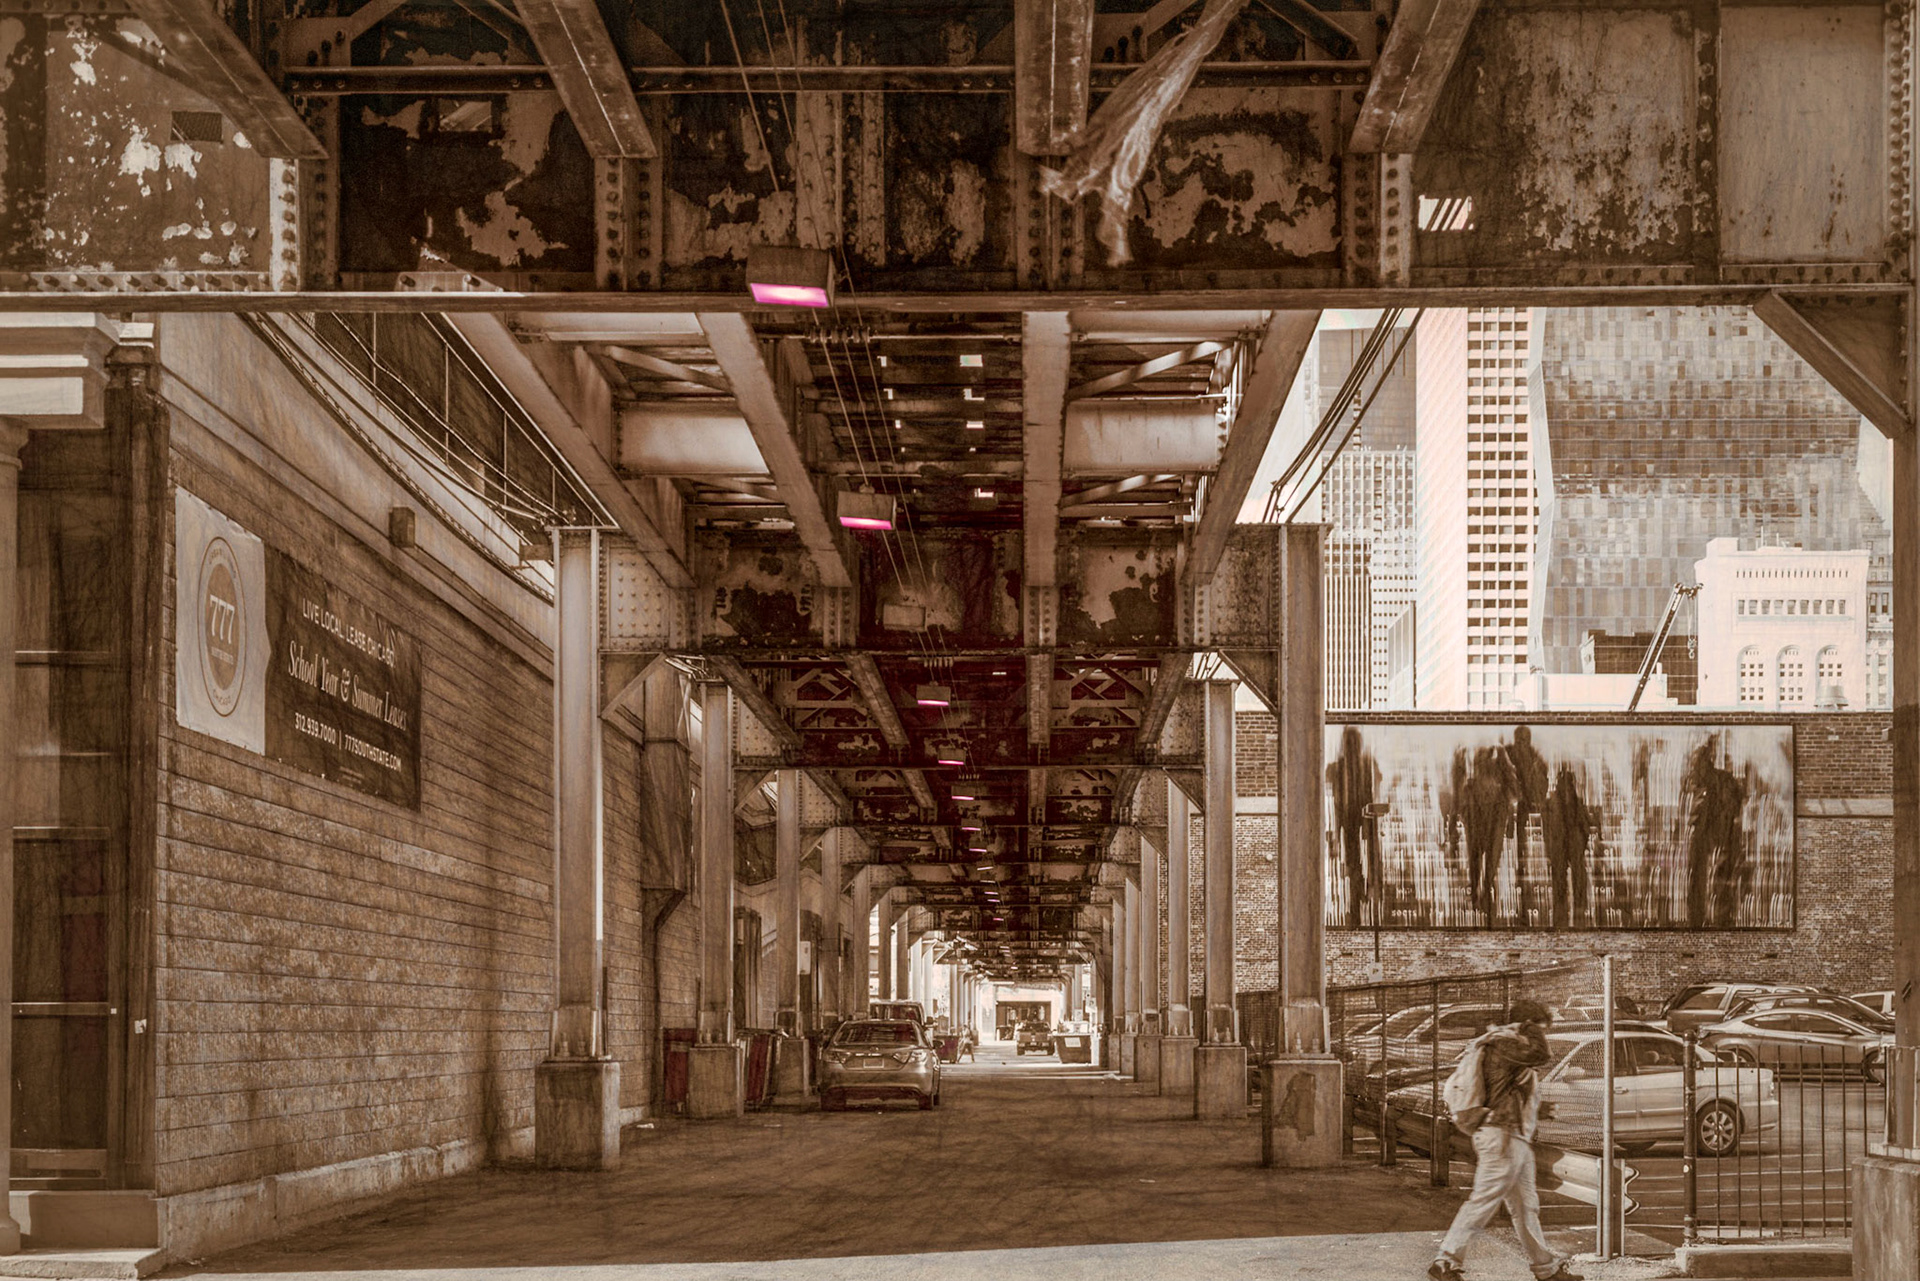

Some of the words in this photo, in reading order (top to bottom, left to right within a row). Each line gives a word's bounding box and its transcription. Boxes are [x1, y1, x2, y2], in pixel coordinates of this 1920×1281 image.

[209, 593, 235, 645] 777
[302, 597, 320, 625] LIVE
[346, 623, 367, 652] LEASE
[288, 639, 319, 688] School
[320, 655, 339, 698] Year
[340, 667, 351, 703] &
[351, 673, 383, 719] Summer
[383, 690, 407, 732] Leases
[294, 711, 336, 745] 312.939.7000
[344, 733, 402, 773] 777SOUTHSTATE.COM
